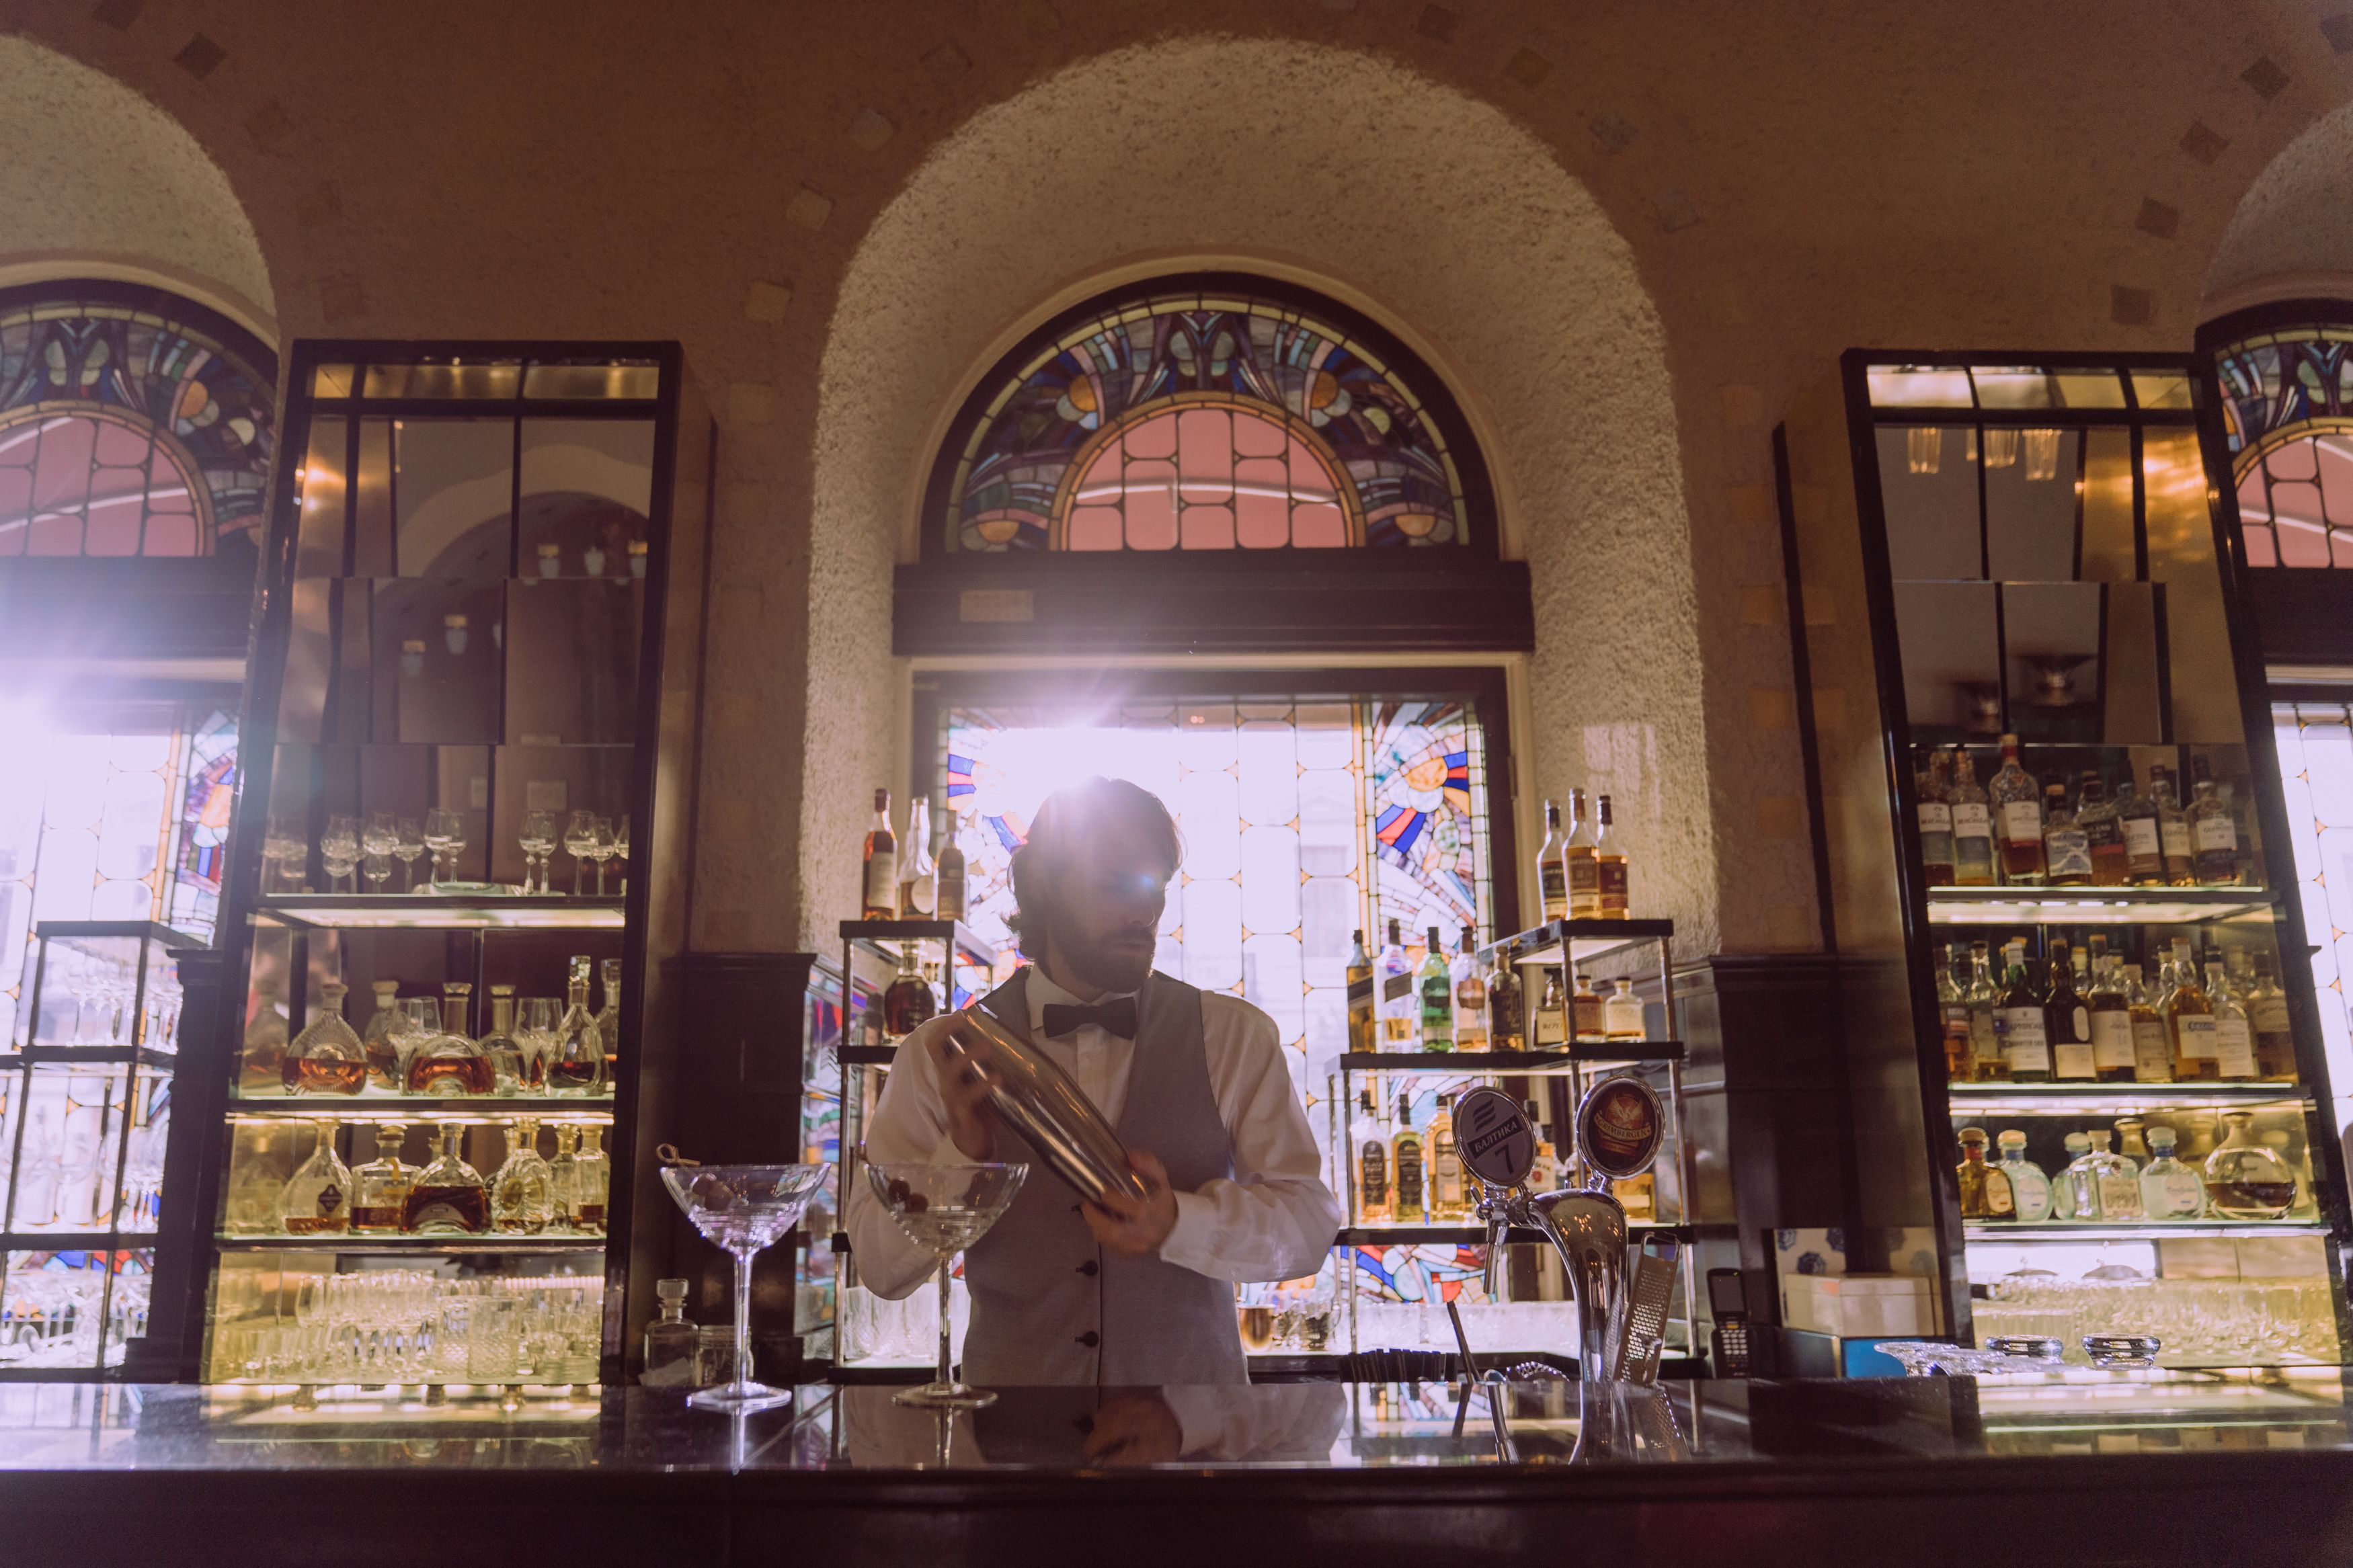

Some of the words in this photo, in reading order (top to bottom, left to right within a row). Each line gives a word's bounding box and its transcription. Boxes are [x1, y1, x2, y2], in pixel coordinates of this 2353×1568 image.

[1474, 1120, 1517, 1153] БАЛТИКА
[1597, 1120, 1646, 1139] GRIMBERGEN
[1494, 1143, 1515, 1173] 7
